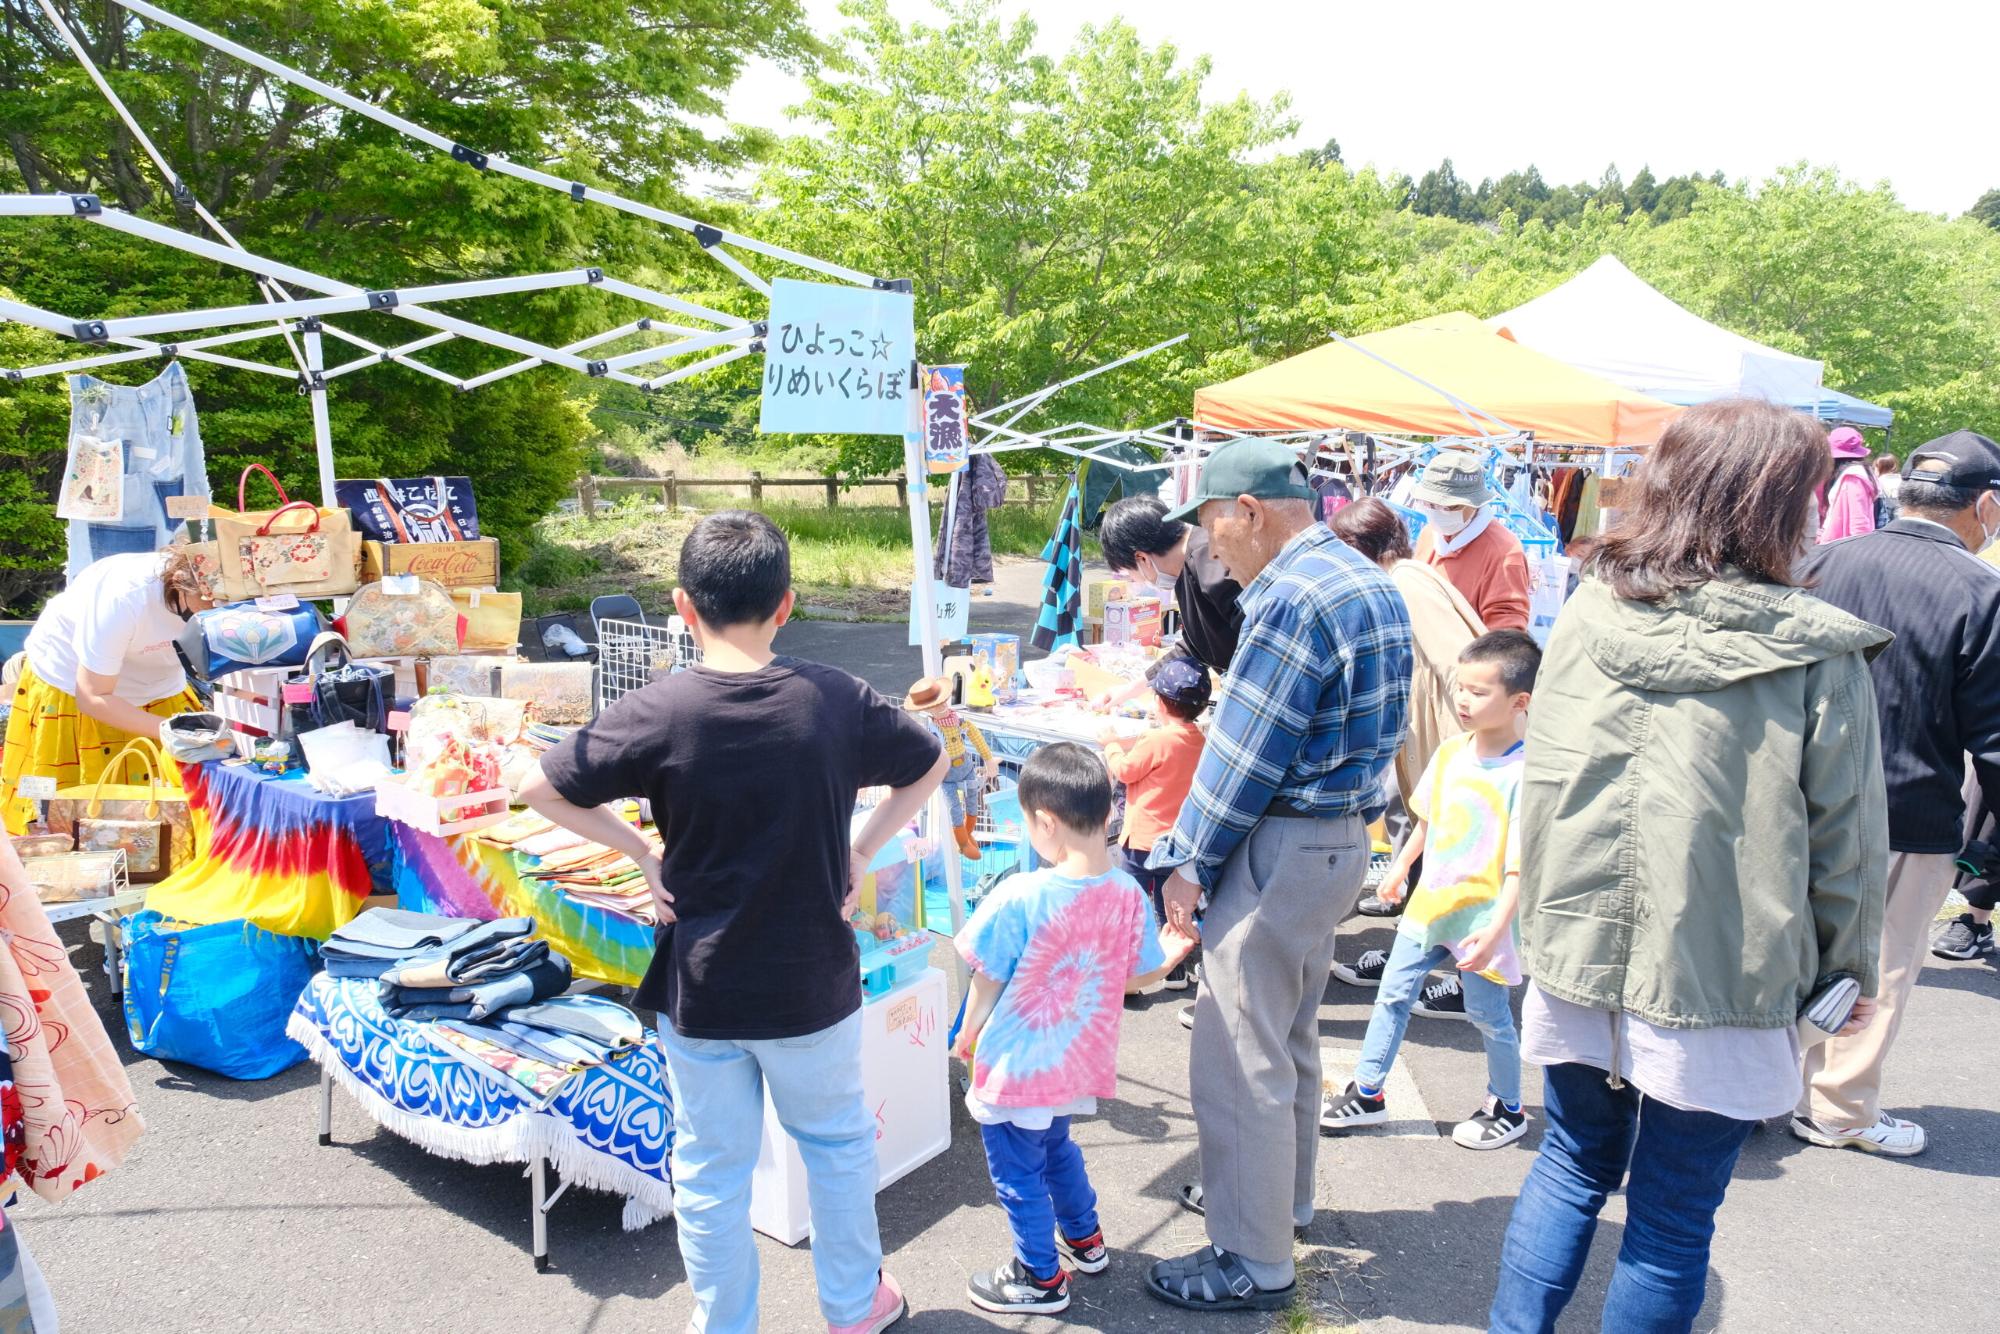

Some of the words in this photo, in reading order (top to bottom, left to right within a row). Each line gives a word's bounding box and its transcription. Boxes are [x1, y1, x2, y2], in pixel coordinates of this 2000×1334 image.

[768, 363, 905, 400] りめいくらぼ
